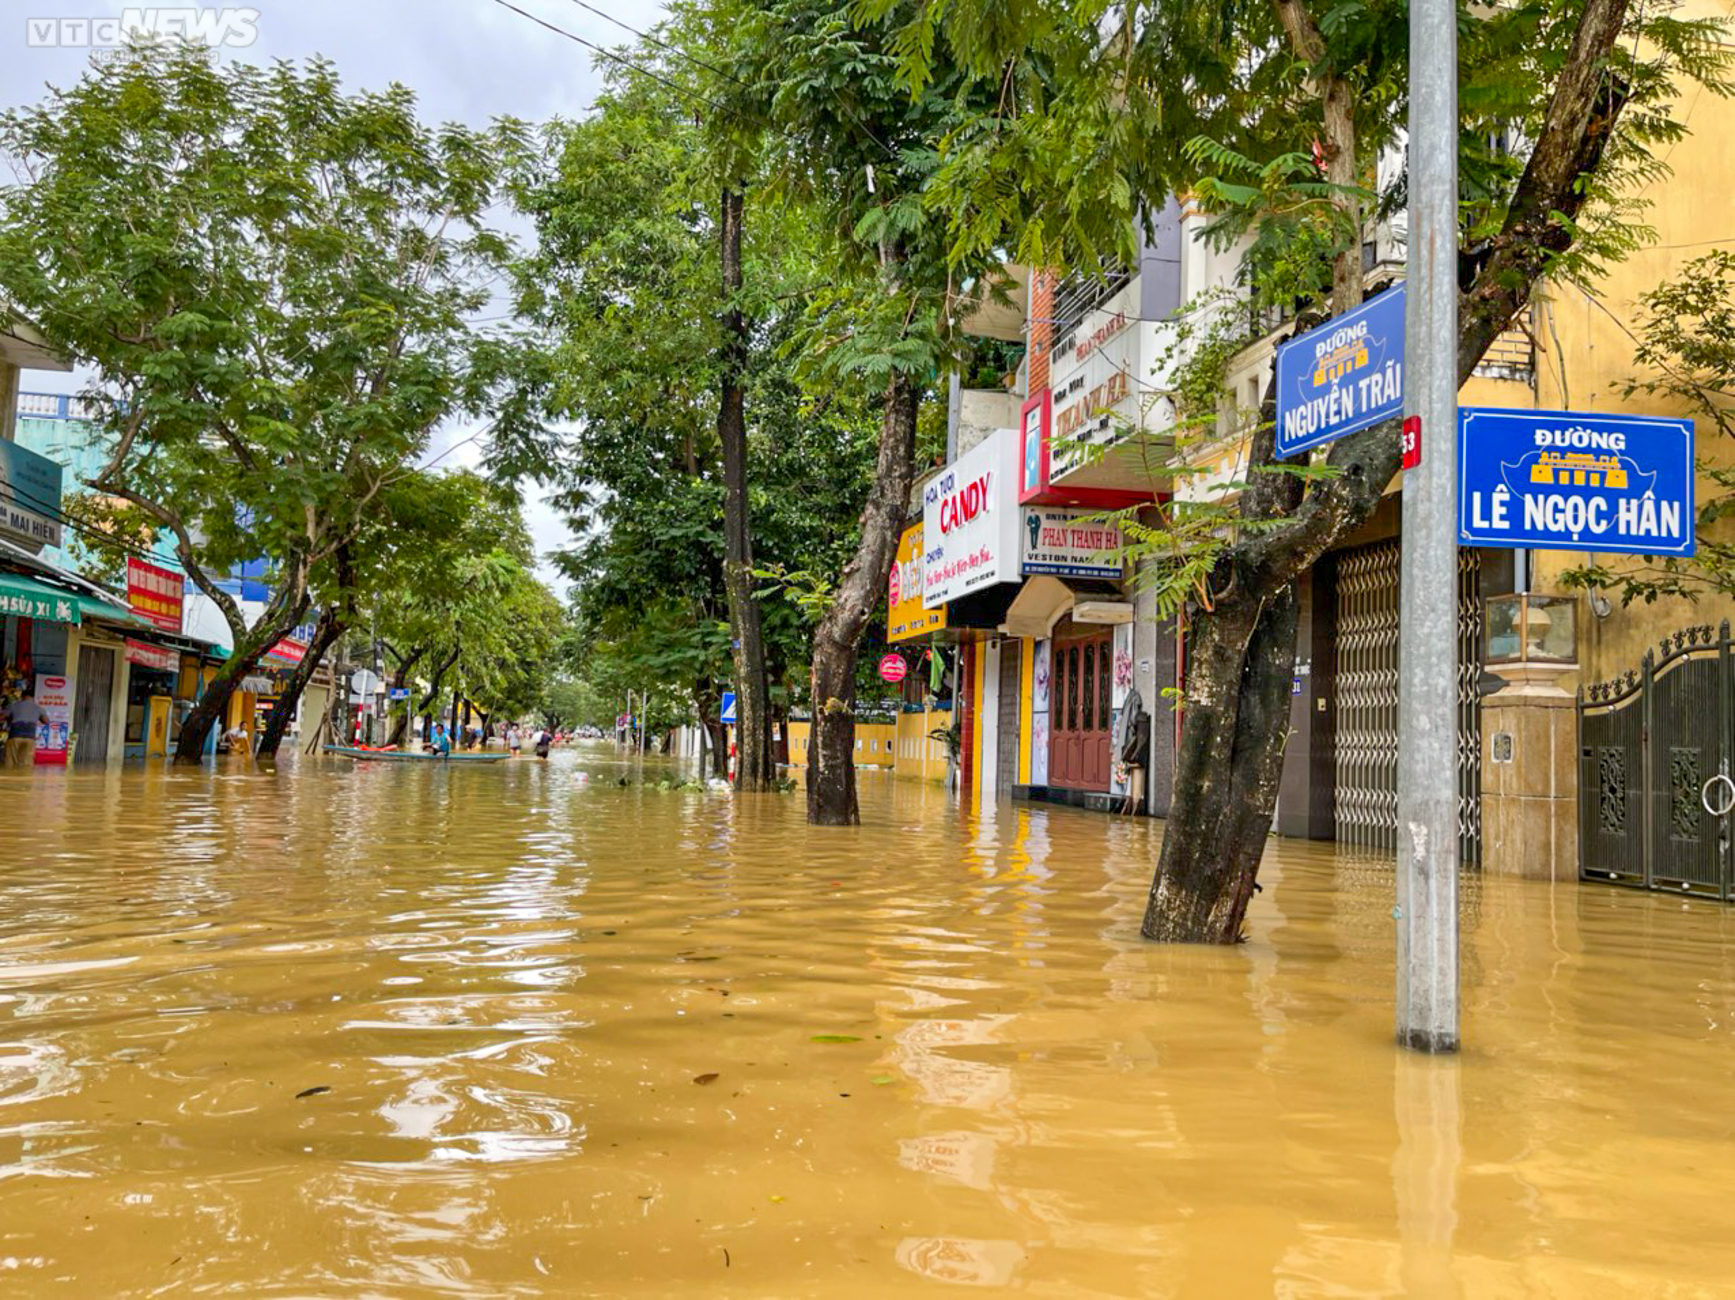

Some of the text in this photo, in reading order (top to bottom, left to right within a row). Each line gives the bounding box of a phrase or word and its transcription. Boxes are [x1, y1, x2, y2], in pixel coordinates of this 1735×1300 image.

[1284, 359, 1401, 442] NGUYỄN TRÃI
[1534, 426, 1626, 450] ĐƯỜNG
[940, 471, 991, 534] CANDY
[1472, 484, 1680, 541] LÊ NGỌC HÂN
